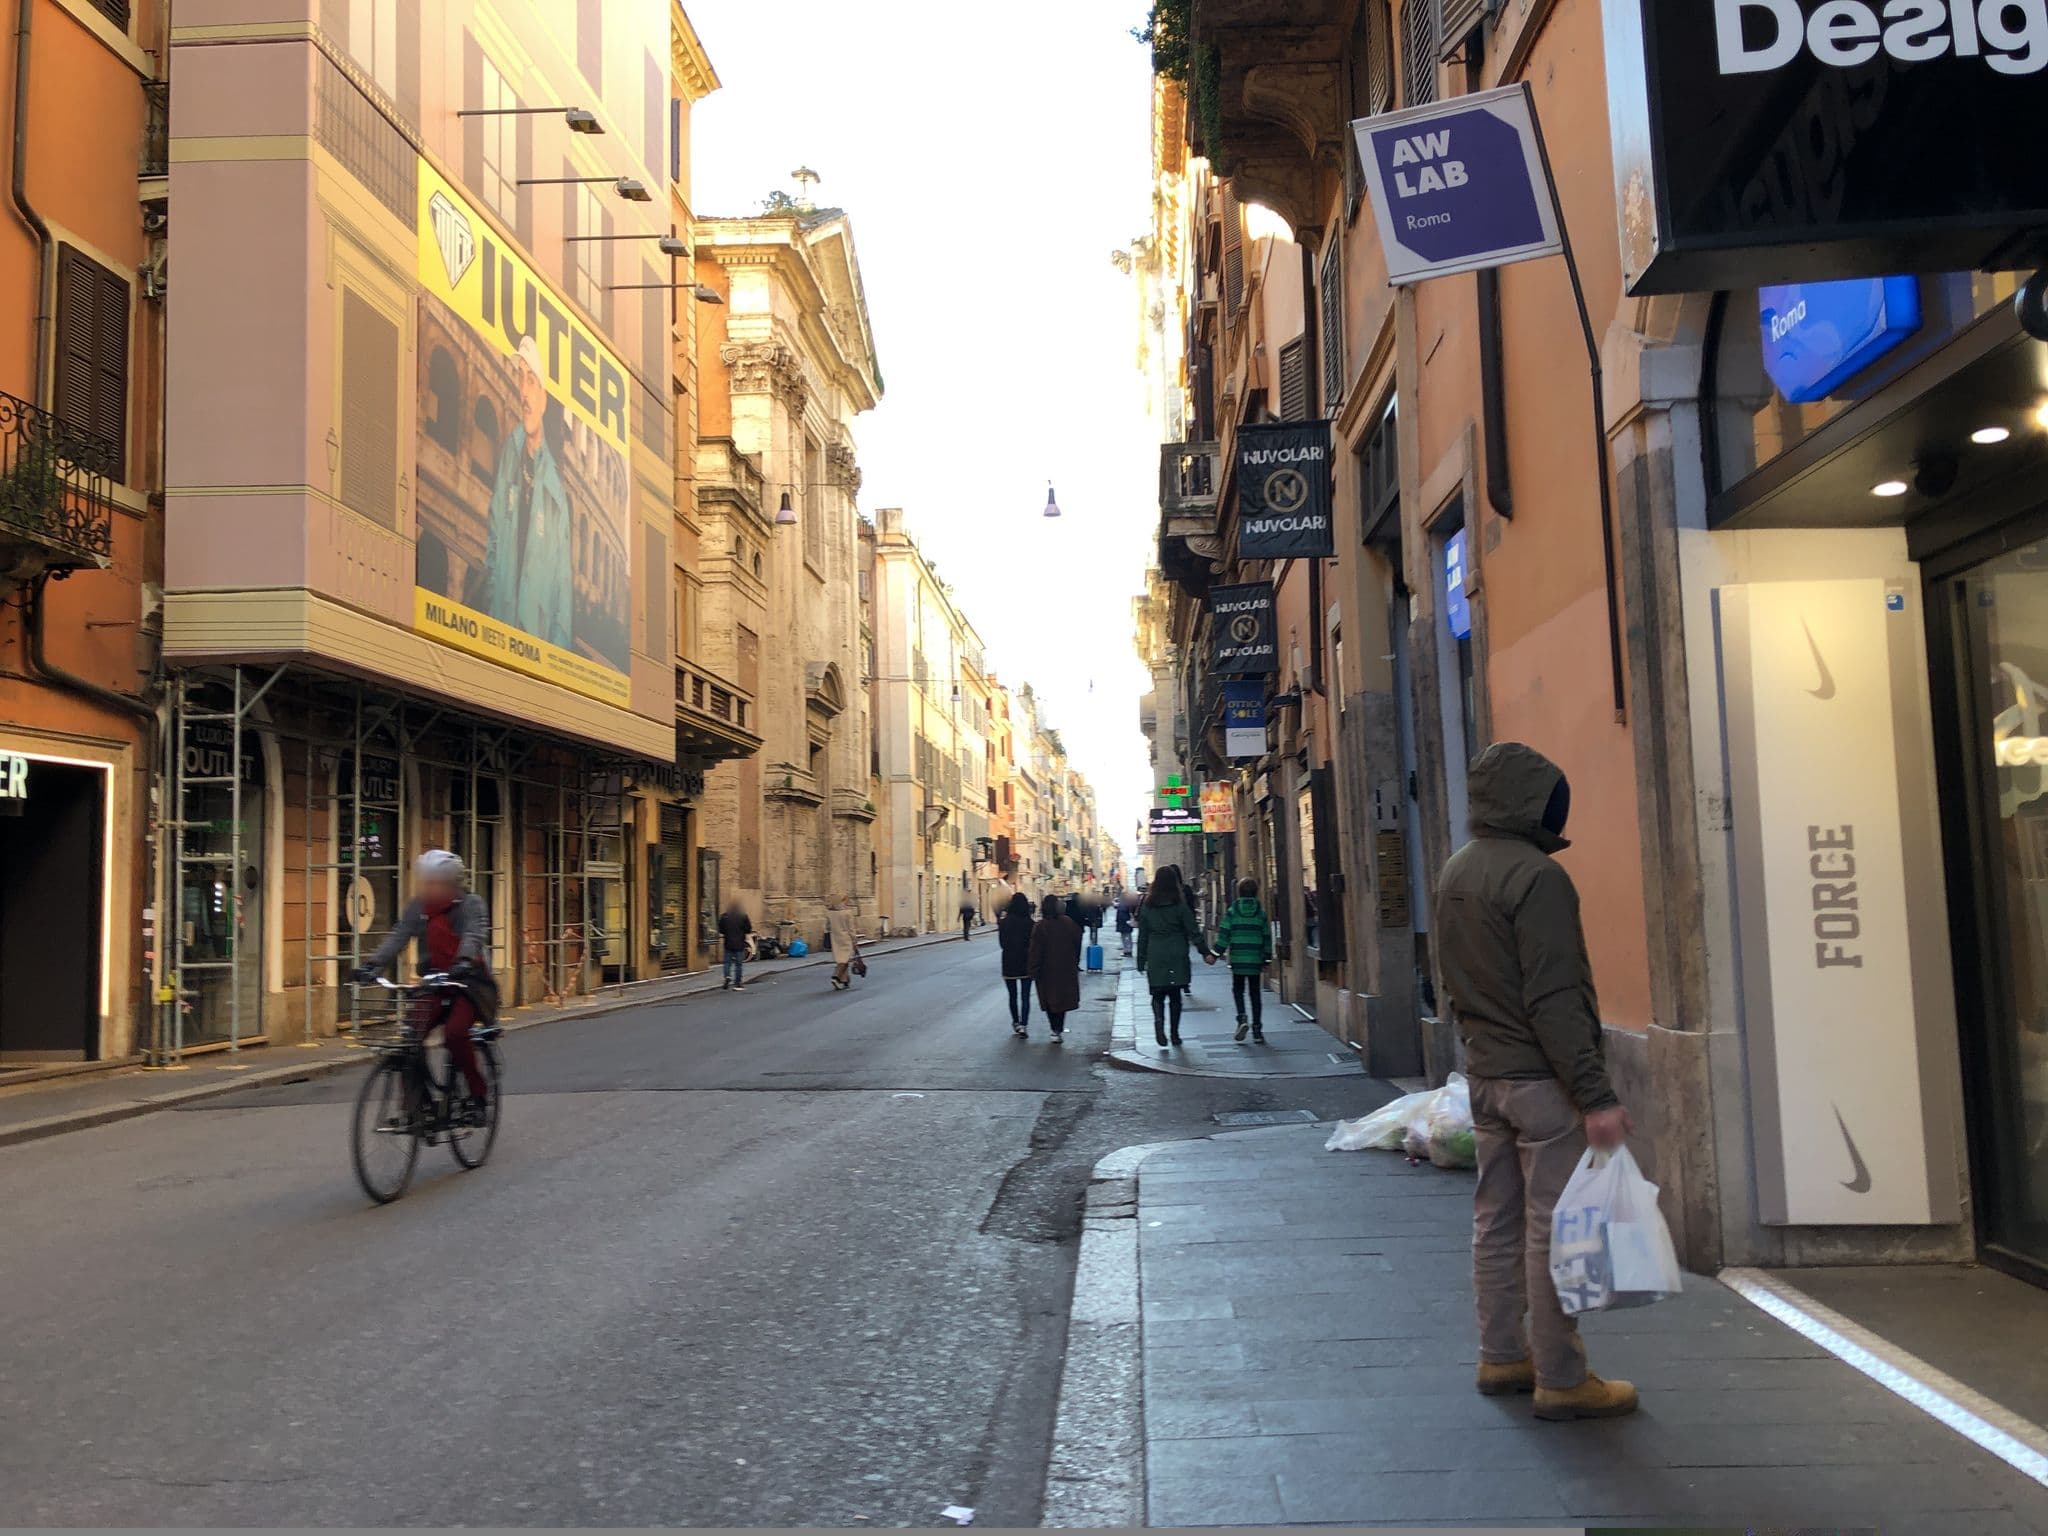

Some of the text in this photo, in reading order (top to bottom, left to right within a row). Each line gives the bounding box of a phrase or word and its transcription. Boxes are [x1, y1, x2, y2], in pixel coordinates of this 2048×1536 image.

[1392, 129, 1450, 168] AW
[1394, 160, 1469, 199] LAB
[1406, 211, 1451, 231] Roma
[481, 234, 627, 444] IUTER
[1771, 300, 1806, 342] Roma
[1243, 446, 1325, 465] NUVOLARI
[1246, 515, 1327, 534] NUVOLARI
[425, 602, 541, 664] MILANO MEETS ROMA
[0, 754, 28, 799] ER
[1808, 824, 1863, 969] FORCE
